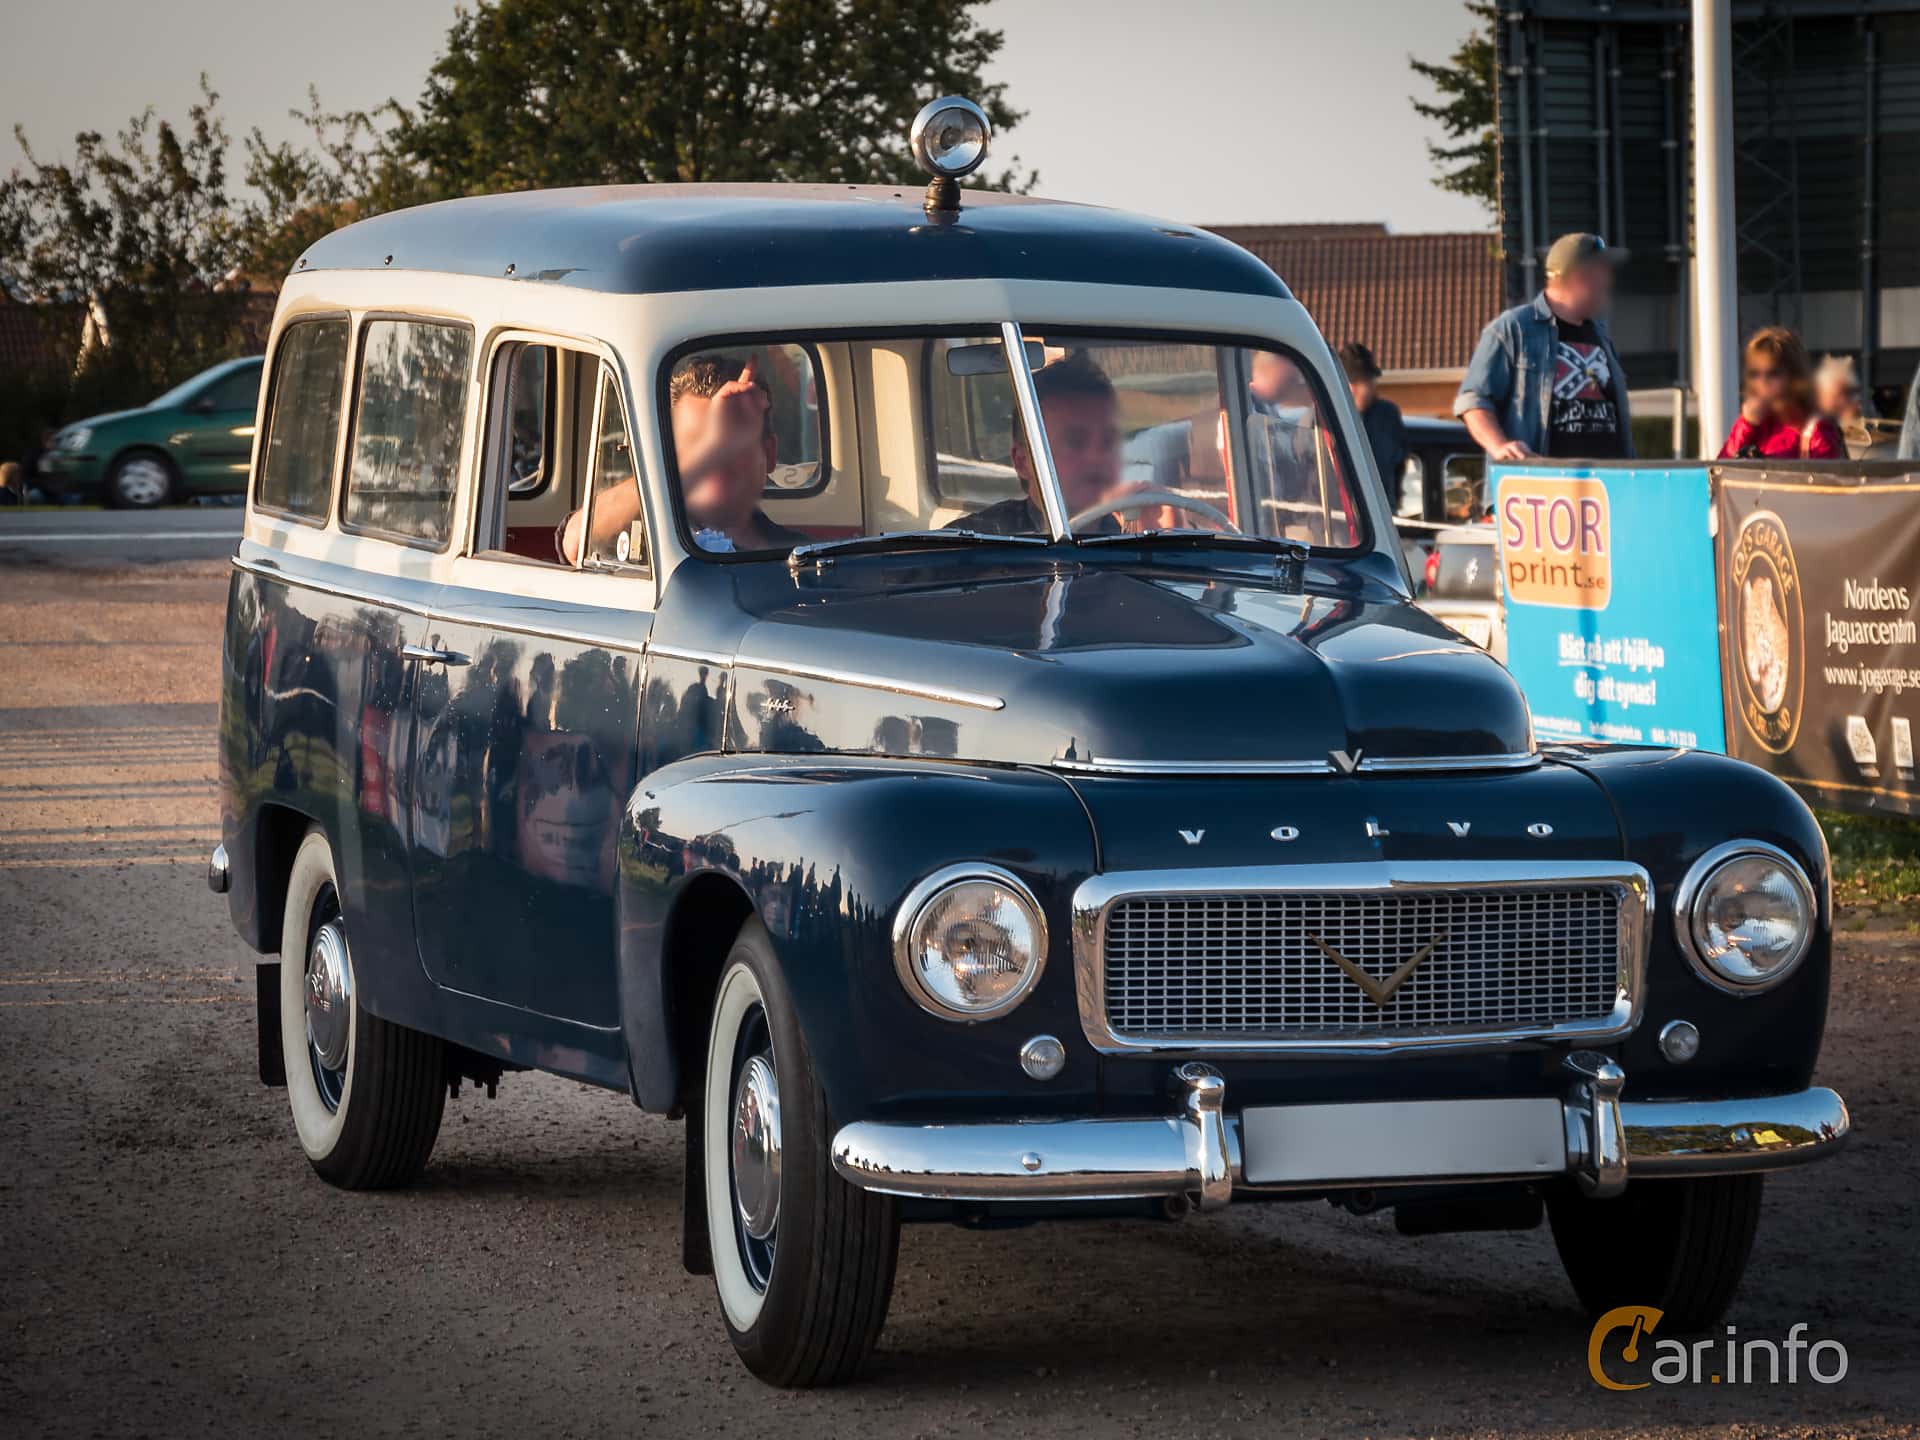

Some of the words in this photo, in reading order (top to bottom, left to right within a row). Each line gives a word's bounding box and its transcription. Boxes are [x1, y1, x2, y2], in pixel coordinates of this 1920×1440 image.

[1505, 497, 1603, 552] STOR
[1755, 522, 1794, 594] GARAGE
[1844, 577, 1910, 611] Nordens
[1178, 820, 1554, 846] VOLVO
